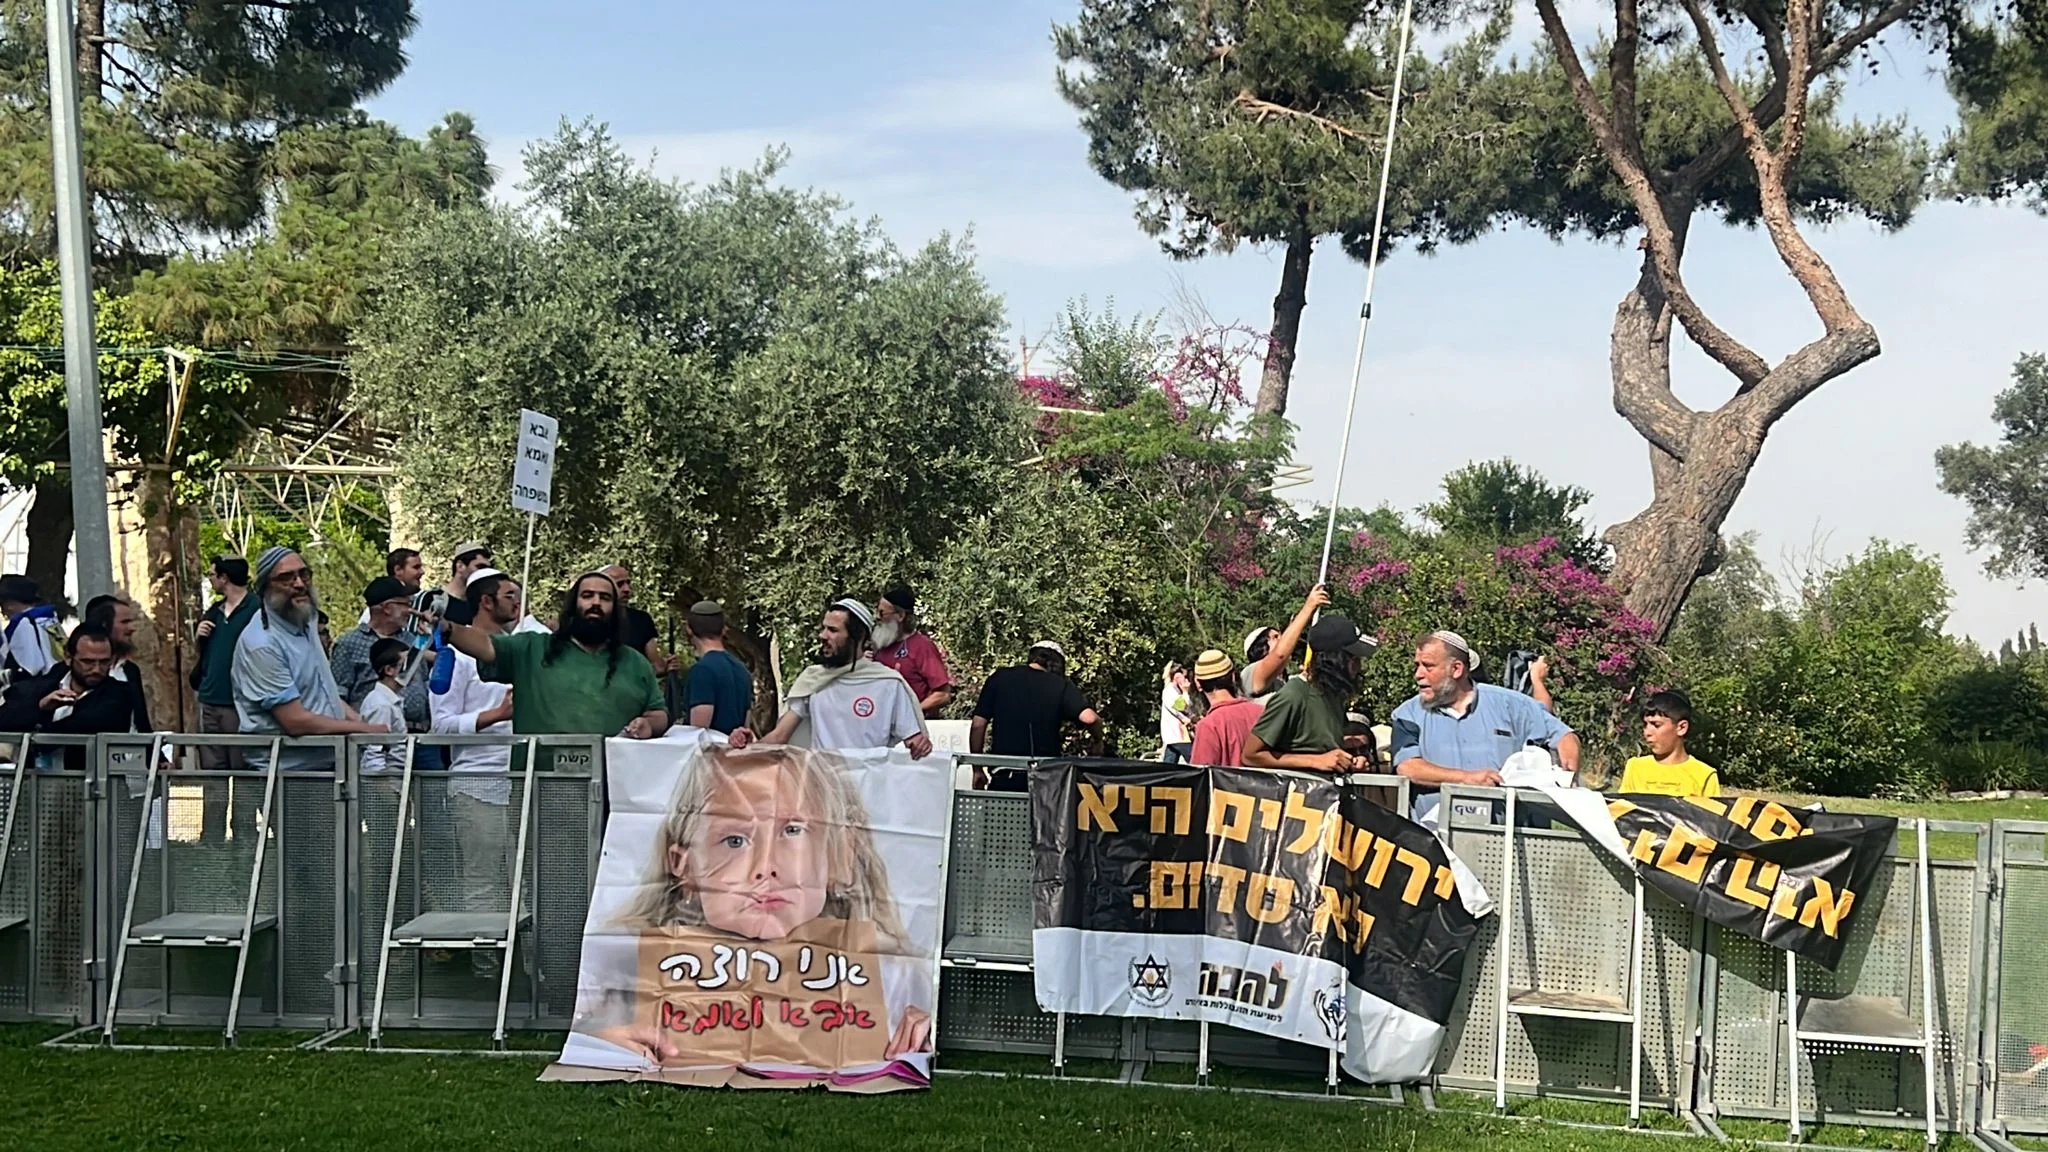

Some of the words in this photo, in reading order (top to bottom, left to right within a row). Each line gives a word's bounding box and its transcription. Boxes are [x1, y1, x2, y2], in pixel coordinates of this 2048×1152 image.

[558, 754, 589, 765] קשת
[1077, 783, 1192, 835] היא
[1206, 781, 1455, 906] ירושלים
[1132, 861, 1295, 924] סדום.
[659, 943, 780, 989] רוצה
[799, 946, 869, 990] אני
[662, 995, 763, 1035] ואמא
[780, 998, 876, 1032] אבא
